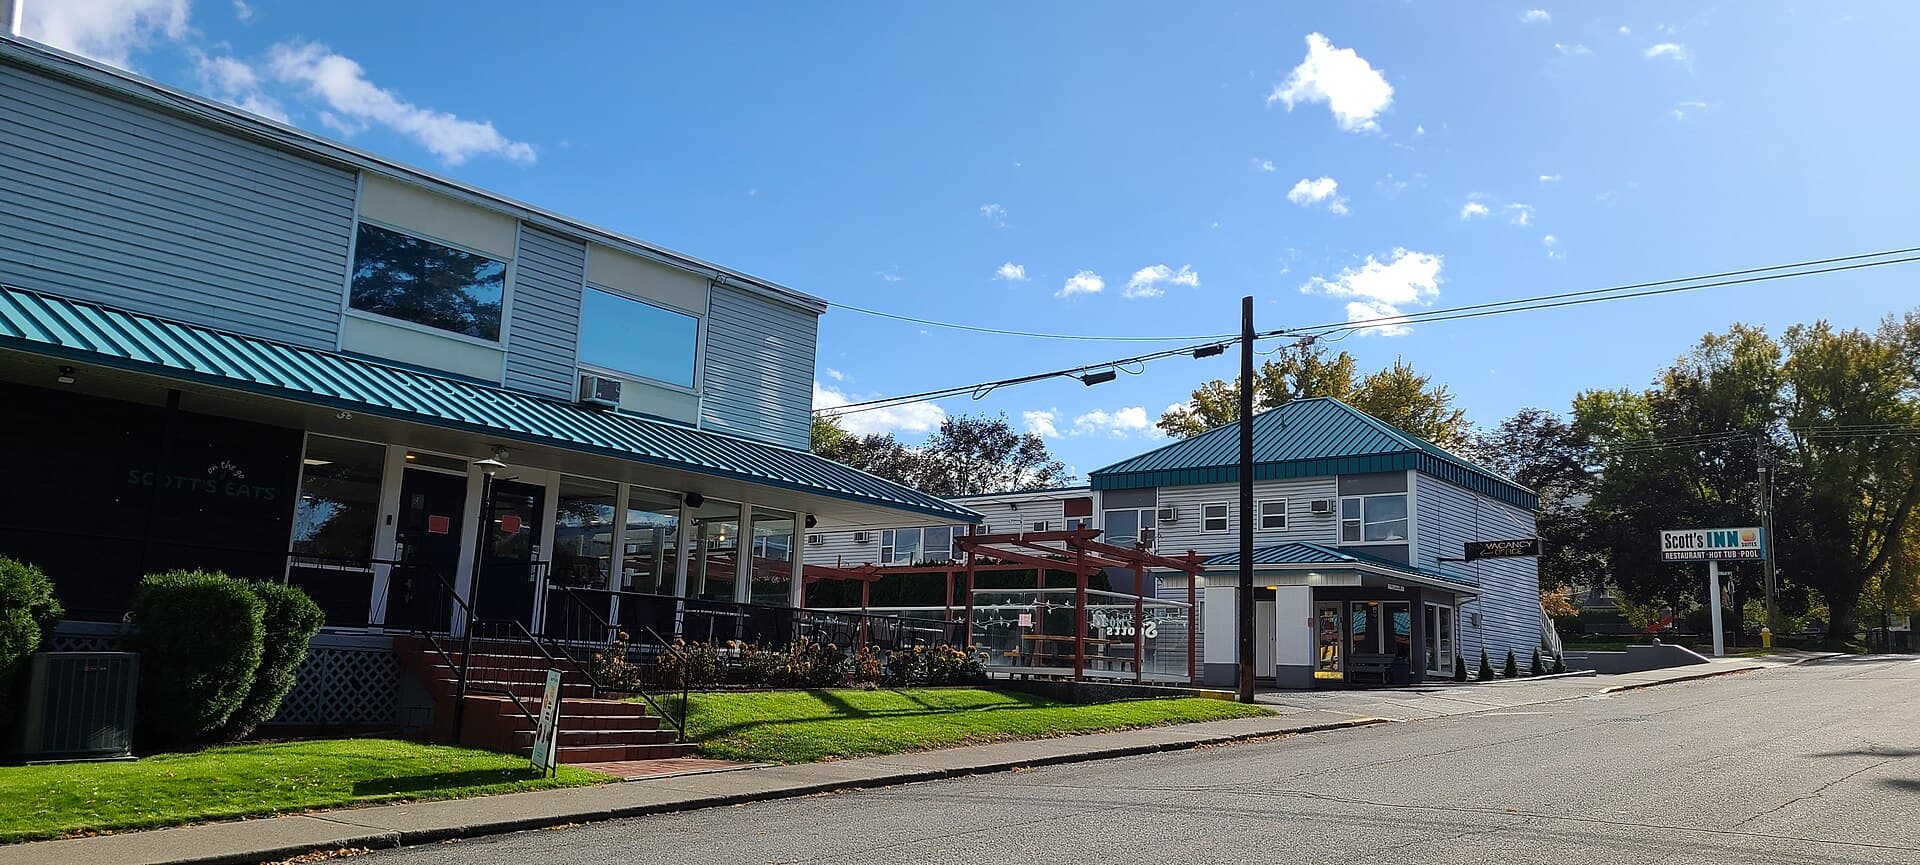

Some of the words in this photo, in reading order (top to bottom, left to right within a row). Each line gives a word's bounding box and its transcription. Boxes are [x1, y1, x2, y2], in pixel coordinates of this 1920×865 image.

[207, 464, 218, 474] on
[220, 460, 236, 471] the
[225, 482, 276, 500] EATS
[1485, 540, 1533, 550] VACANCY
[1665, 533, 1704, 549] Scott's
[1707, 531, 1738, 547] INN
[1665, 552, 1705, 560] RESTAURANT
[1709, 551, 1722, 559] HOT
[1740, 550, 1759, 558] POOL
